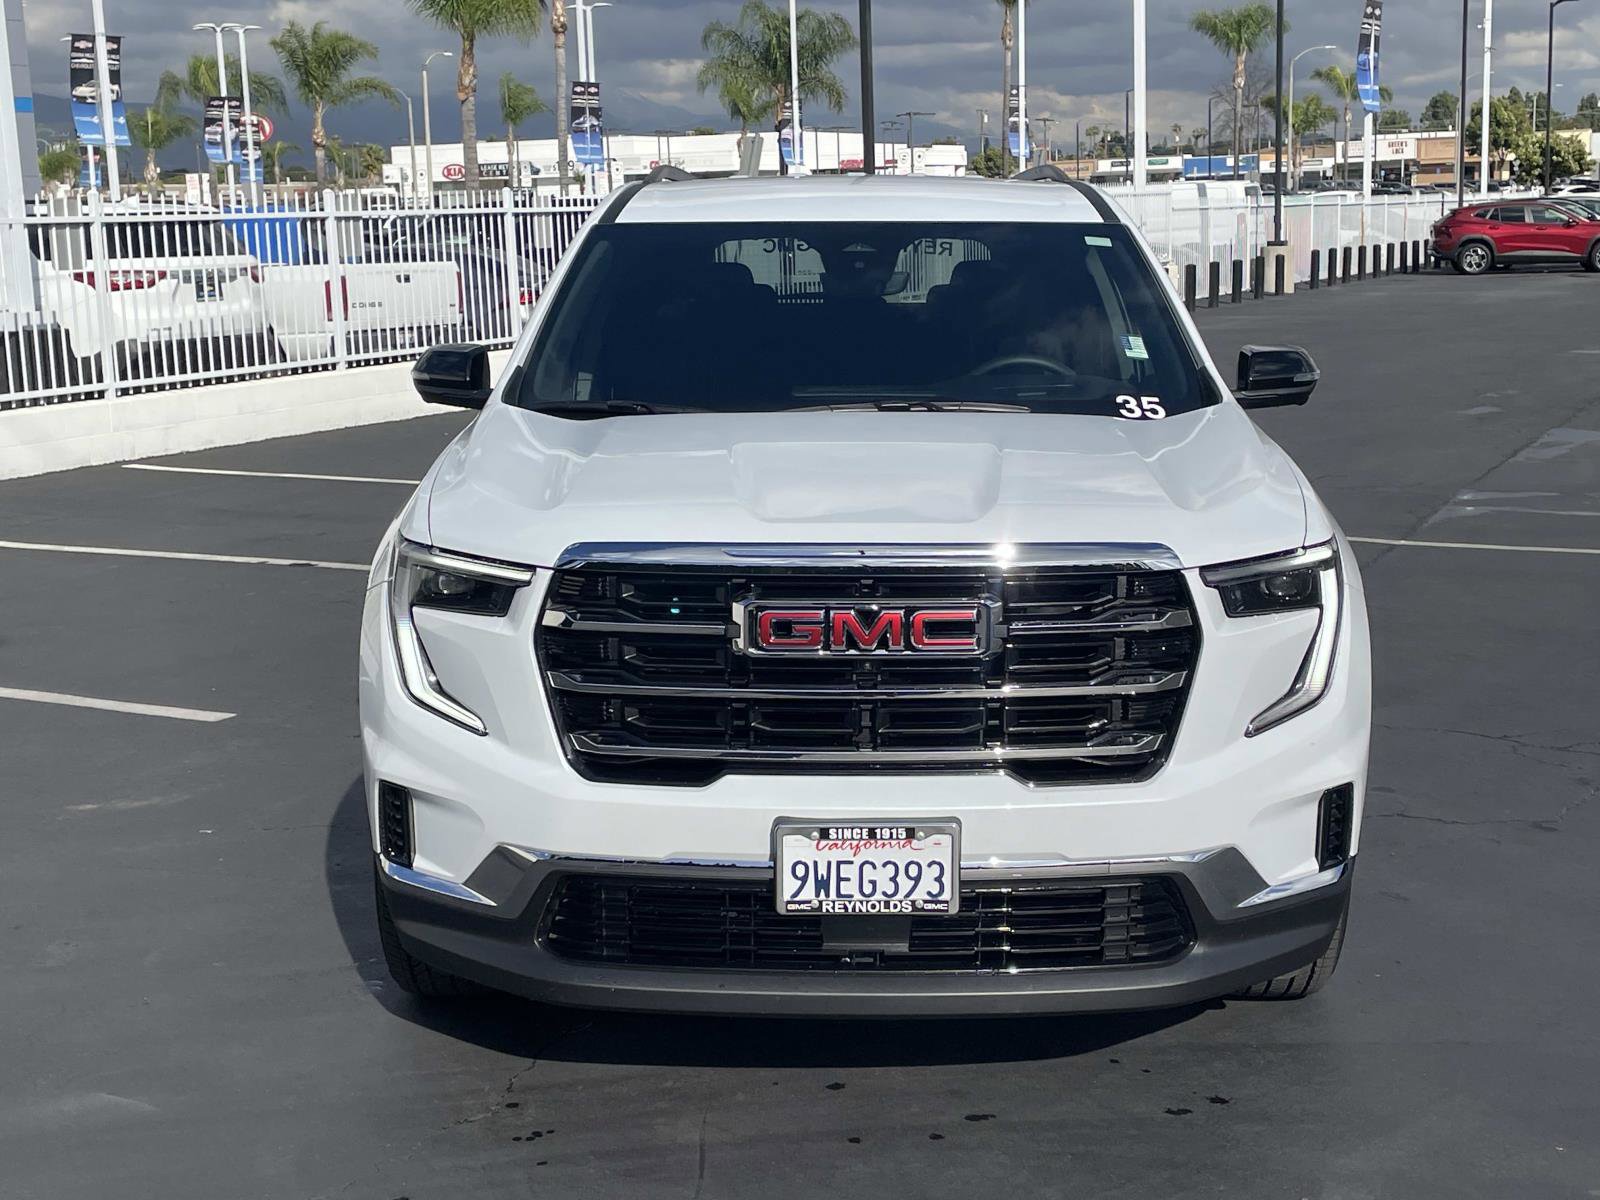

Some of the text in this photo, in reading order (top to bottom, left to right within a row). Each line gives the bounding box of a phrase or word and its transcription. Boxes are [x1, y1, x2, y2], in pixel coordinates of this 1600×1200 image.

[446, 167, 464, 177] KIA
[1115, 394, 1167, 420] 35
[757, 608, 980, 651] GMC
[828, 828, 907, 840] SINCE 1915
[816, 838, 925, 857] California
[790, 860, 945, 899] 9WEG393
[822, 900, 913, 913] REYNOLDS
